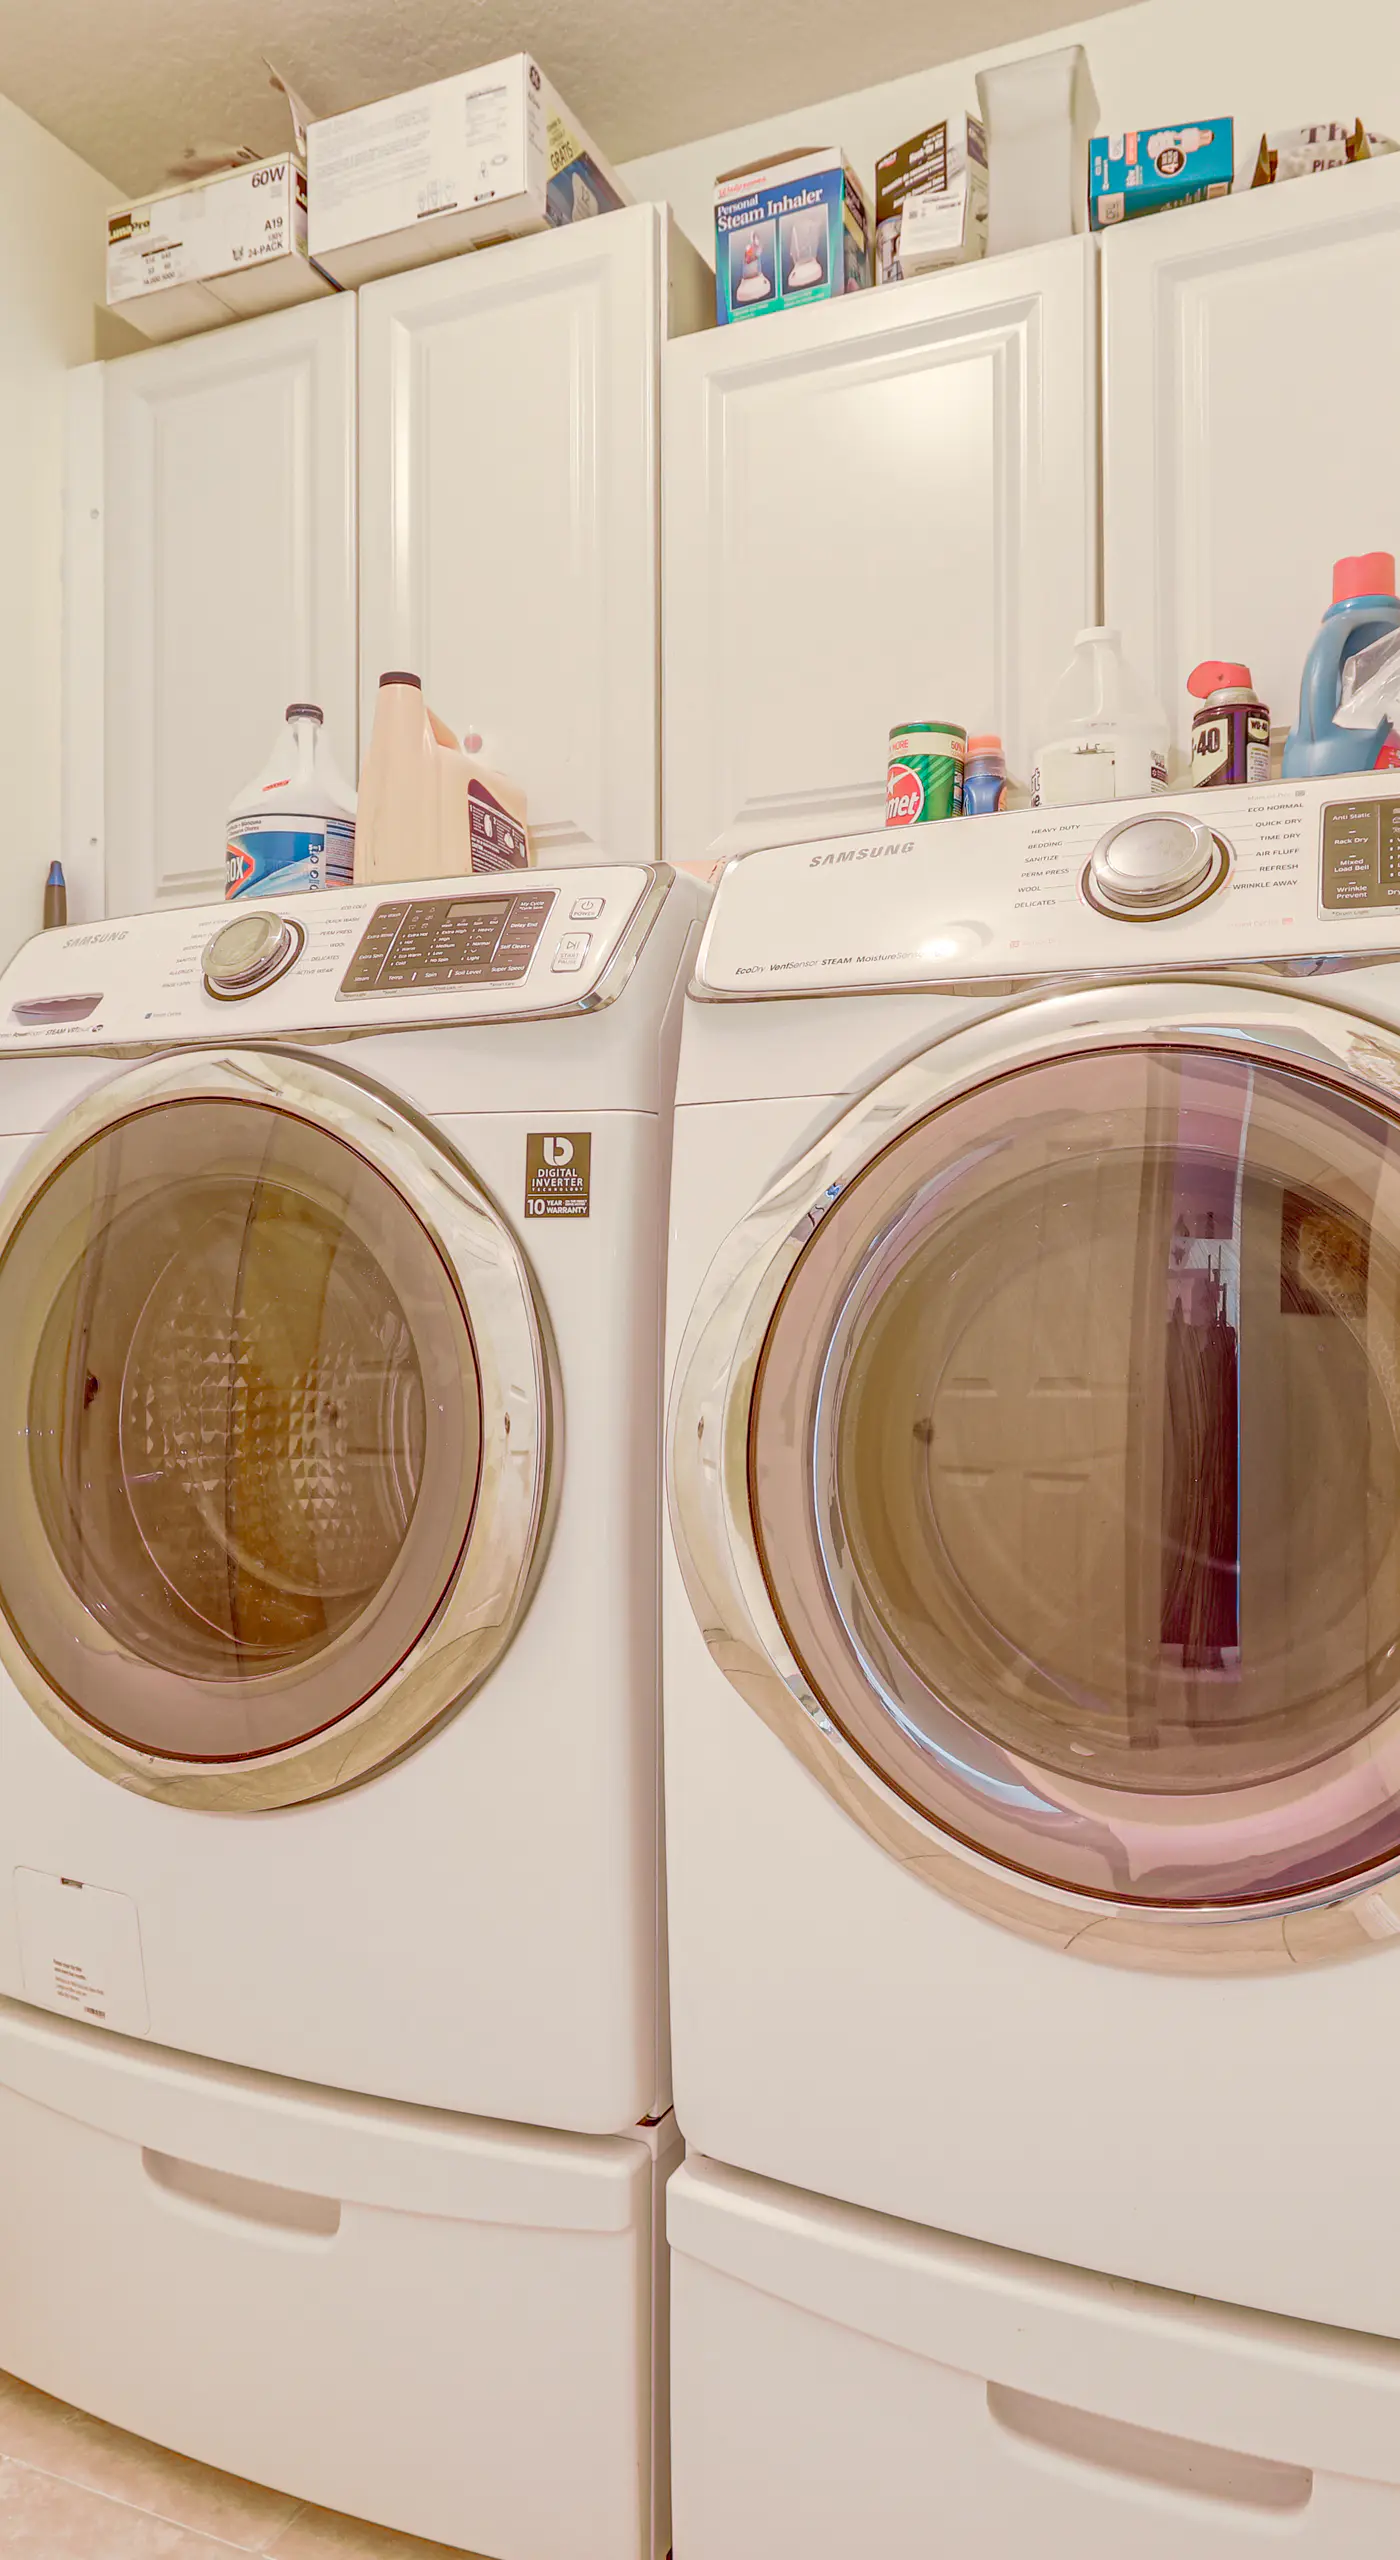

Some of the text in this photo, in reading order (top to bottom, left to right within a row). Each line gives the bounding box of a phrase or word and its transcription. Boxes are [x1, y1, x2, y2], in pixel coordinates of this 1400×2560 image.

[550, 141, 573, 171] GRATIS
[252, 166, 285, 188] 60W
[717, 194, 758, 216] Personal
[717, 208, 764, 232] Steam
[767, 189, 823, 217] Inhaler
[264, 216, 283, 231] A19
[248, 242, 283, 258] 24-PACK
[1267, 803, 1304, 811] NORMAL
[1255, 820, 1282, 828] QUICK
[1027, 841, 1063, 850] BEDDING
[809, 841, 915, 868] SAMSUNG
[1024, 855, 1059, 863] SANITIZE
[1259, 864, 1299, 872] REFRESH
[1232, 879, 1298, 890] WRINKLE AWAY
[1336, 885, 1368, 893] Wrinkle
[1014, 900, 1056, 909] DELICATES
[62, 930, 130, 949] SAMSUNG
[735, 966, 766, 976] EcoDry
[769, 959, 818, 972] VentSensor
[821, 957, 852, 966] STEAM
[538, 1168, 578, 1178] DIGITAL
[532, 1178, 583, 1187] INVERTER
[527, 1198, 546, 1215] 10
[546, 1206, 587, 1214] WARRANTY
